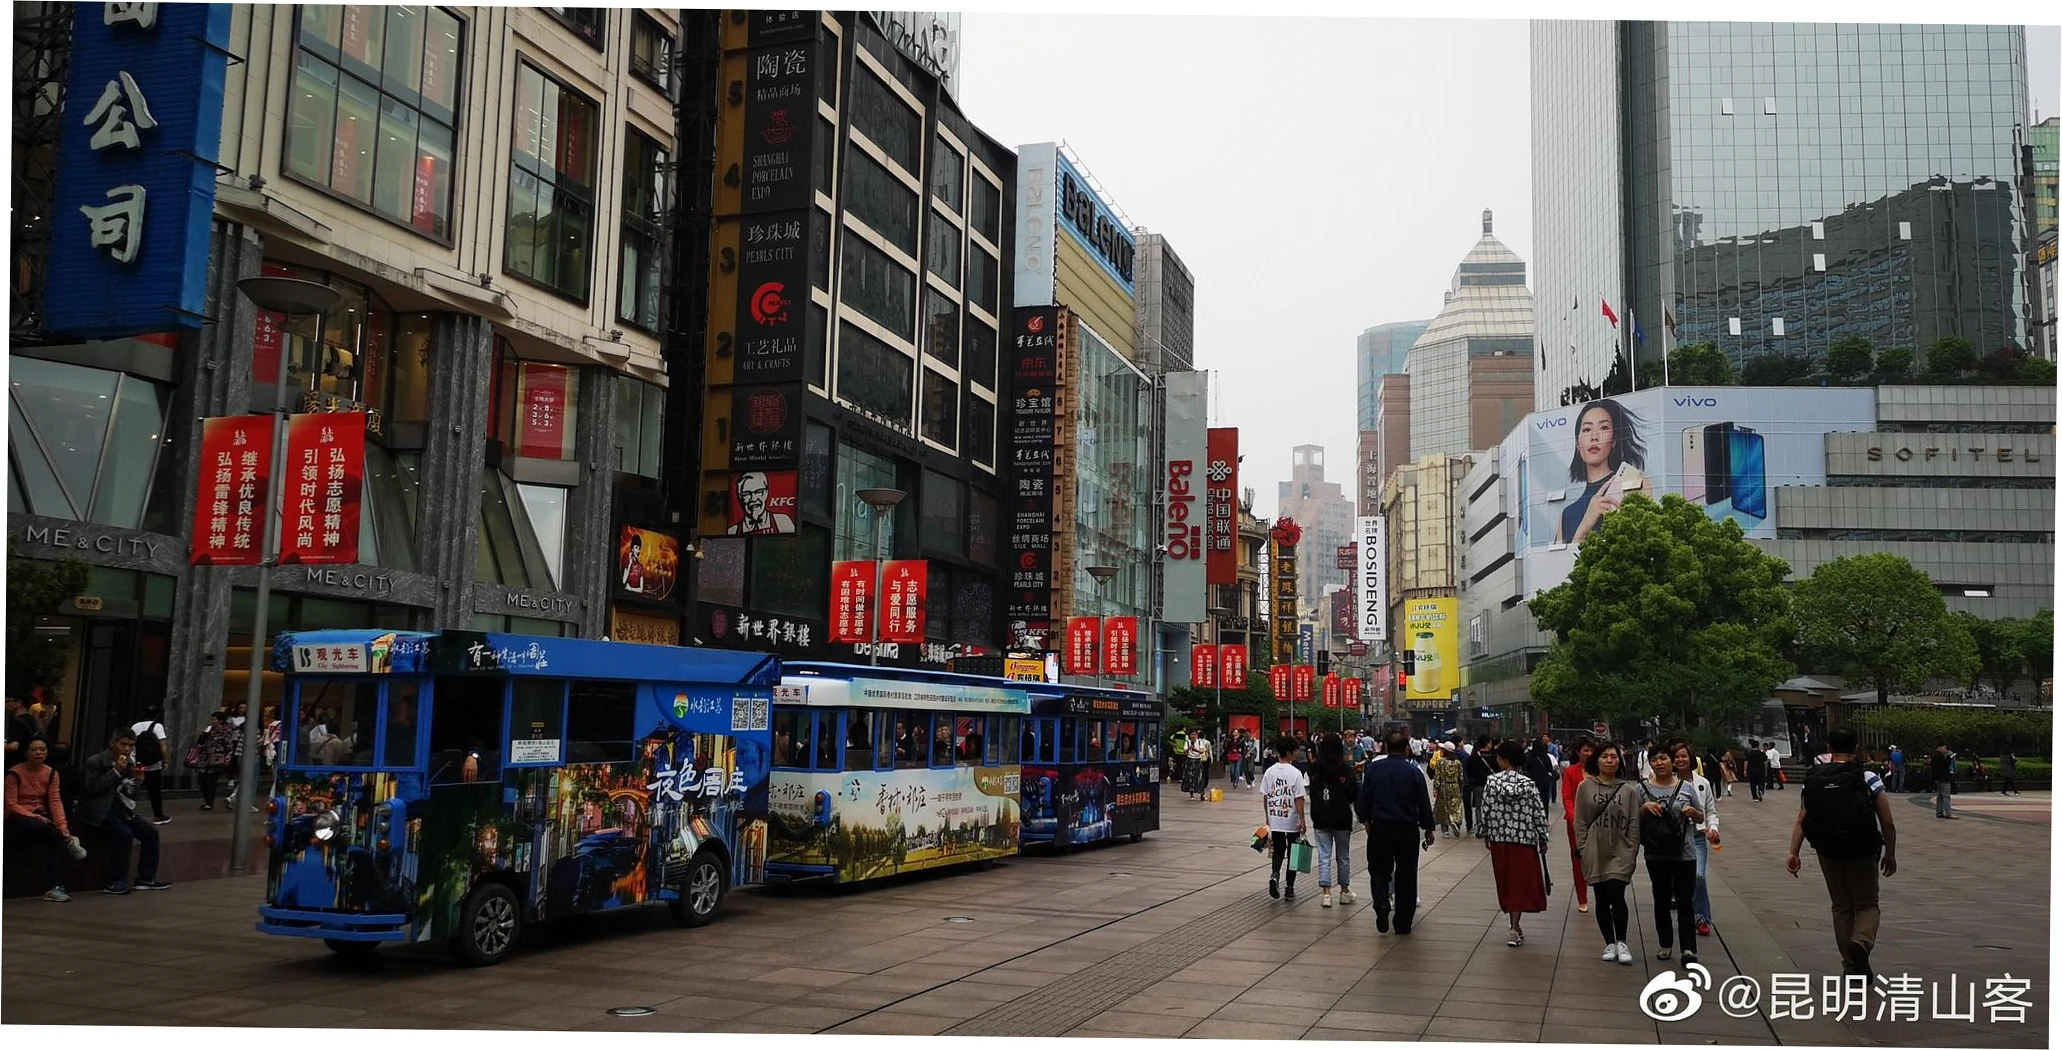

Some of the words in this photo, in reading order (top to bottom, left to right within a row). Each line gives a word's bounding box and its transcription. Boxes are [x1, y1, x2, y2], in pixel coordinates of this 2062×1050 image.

[757, 50, 806, 80] 陶瓷
[757, 83, 801, 101] 精品商场
[753, 151, 789, 167] SHANGHAI
[752, 167, 794, 184] PORCELAIN
[752, 186, 771, 200] EXPO
[748, 221, 800, 243] 珍珠城
[719, 246, 735, 274] 3
[746, 249, 773, 264] PEARLS
[775, 247, 794, 260] CITY
[715, 331, 733, 358] 2
[745, 338, 797, 356] 工艺礼品
[764, 359, 791, 369] CRAFTS
[1673, 395, 1716, 407] vivo
[1056, 426, 1062, 436] 7
[1537, 417, 1567, 429] vivo
[1867, 447, 2040, 463] SOFITEL
[1366, 451, 1377, 517] 上海置地广
[209, 451, 233, 549] 弘扬雷锋精神
[234, 451, 258, 549] 继承优良传统
[297, 449, 319, 548] 引领时代风尚
[323, 448, 345, 547] 弘扬志愿精神
[769, 497, 795, 507] KFC
[1168, 461, 1195, 559] Baleno
[1216, 487, 1231, 550] 中国联通
[27, 525, 71, 547] ME
[77, 537, 89, 549] &
[96, 536, 160, 557] CITY
[307, 567, 335, 585] ME
[341, 576, 350, 587] &
[354, 574, 397, 592] CITY
[1366, 536, 1377, 626] BOSIDENG
[507, 592, 528, 608] ME
[540, 597, 572, 612] CITY
[889, 580, 901, 633] 与爱同行
[905, 579, 918, 633] 志愿服务
[1028, 628, 1049, 636] KFC
[316, 647, 359, 661] 观光车
[646, 757, 748, 802] 夜色周庄
